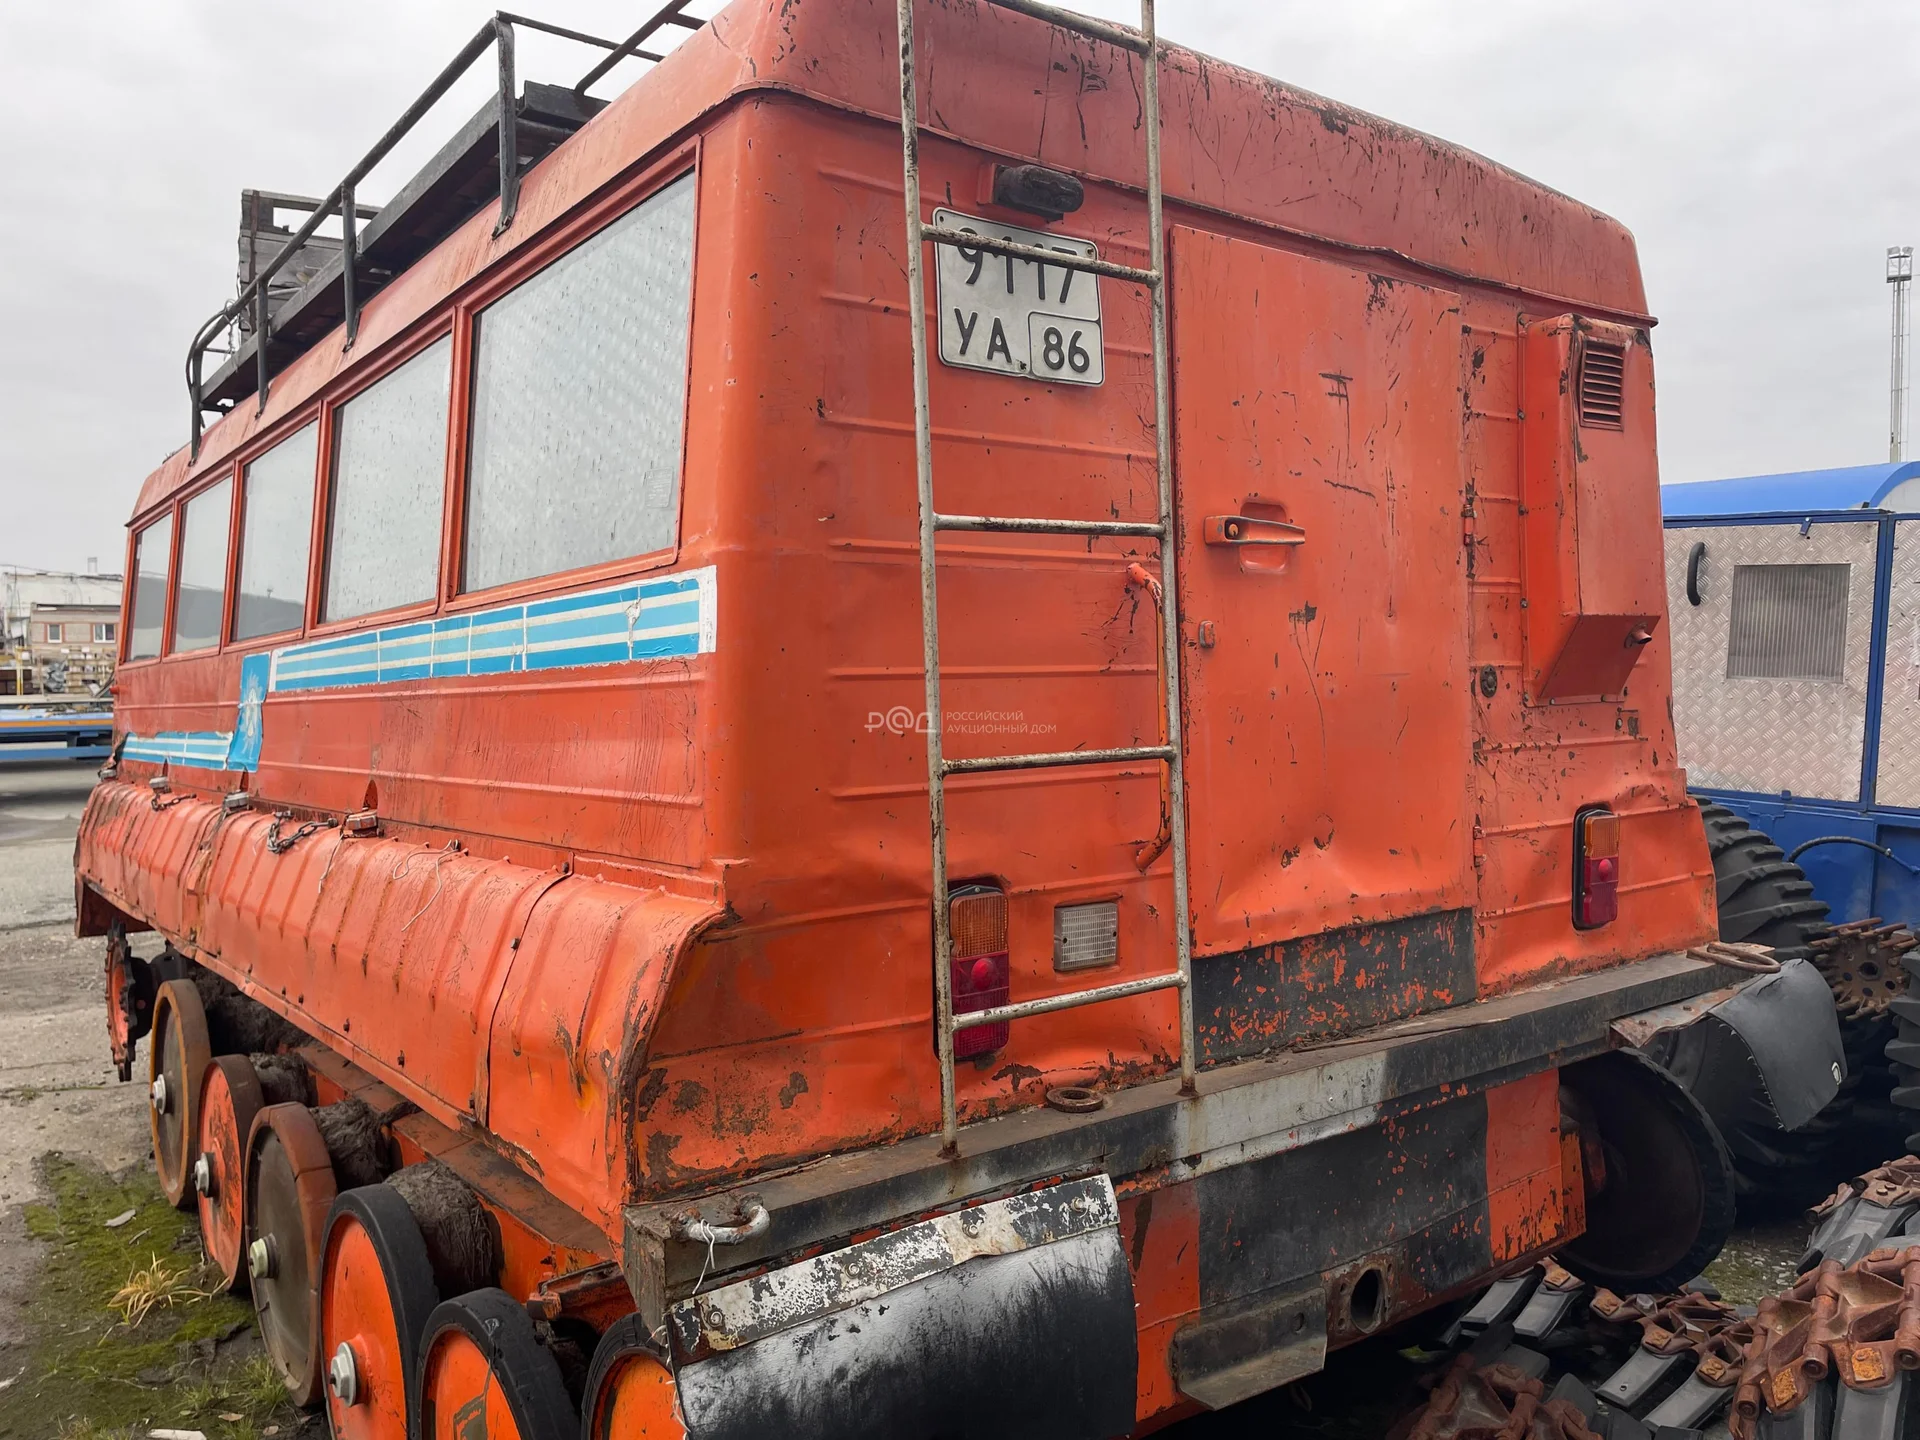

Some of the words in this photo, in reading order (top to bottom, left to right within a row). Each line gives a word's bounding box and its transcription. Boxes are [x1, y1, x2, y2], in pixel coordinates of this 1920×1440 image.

[957, 227, 1078, 304] 9117
[954, 308, 1013, 364] УА
[1043, 326, 1090, 374] 86
